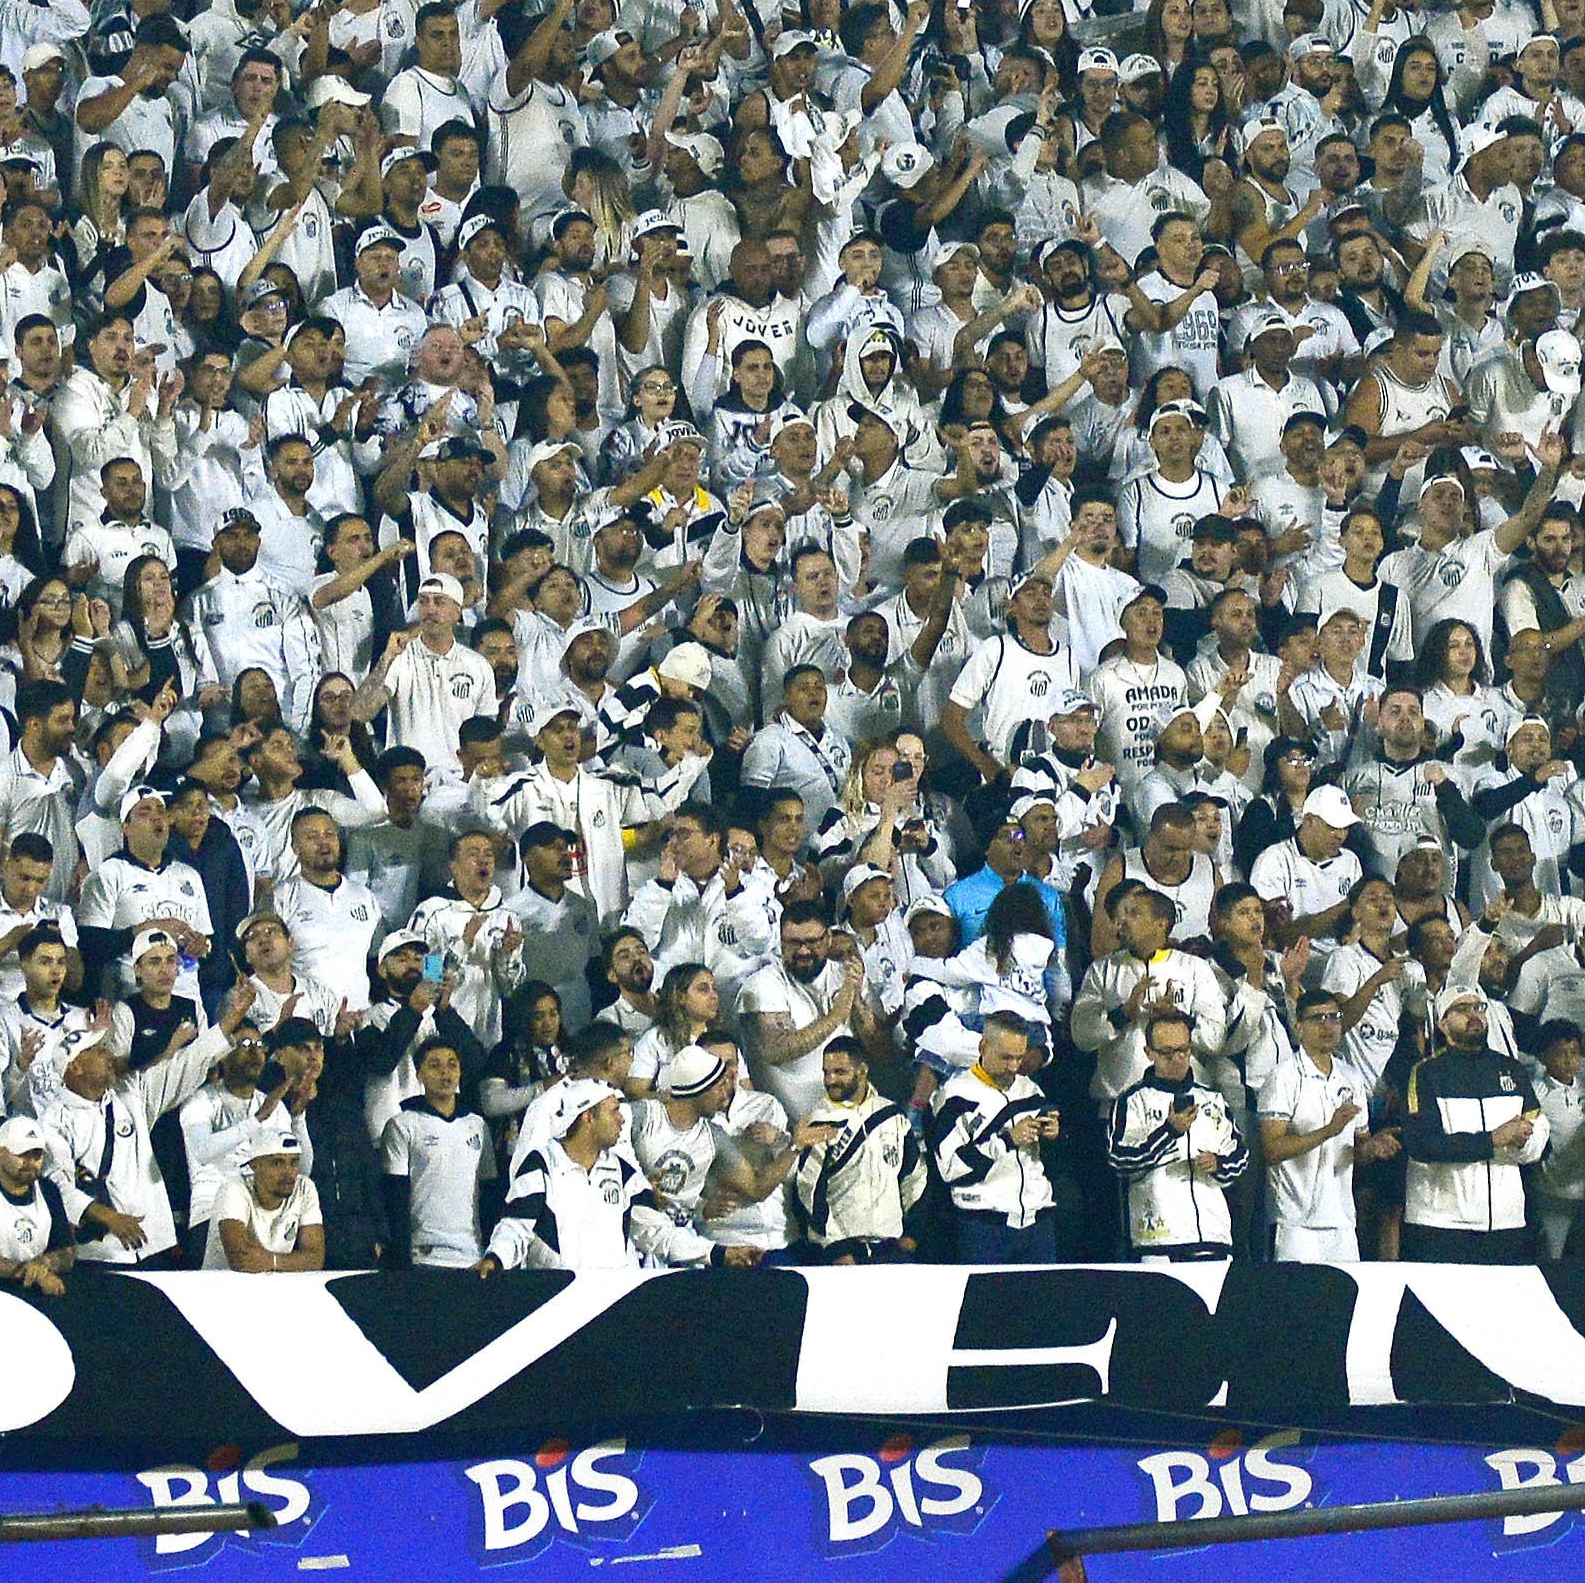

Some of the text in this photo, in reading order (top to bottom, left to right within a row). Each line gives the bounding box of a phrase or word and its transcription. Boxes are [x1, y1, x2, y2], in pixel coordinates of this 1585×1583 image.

[733, 316, 793, 339] JOVEM
[1181, 310, 1218, 341] 969
[1125, 685, 1178, 704] AMADA
[1123, 746, 1156, 759] RESP
